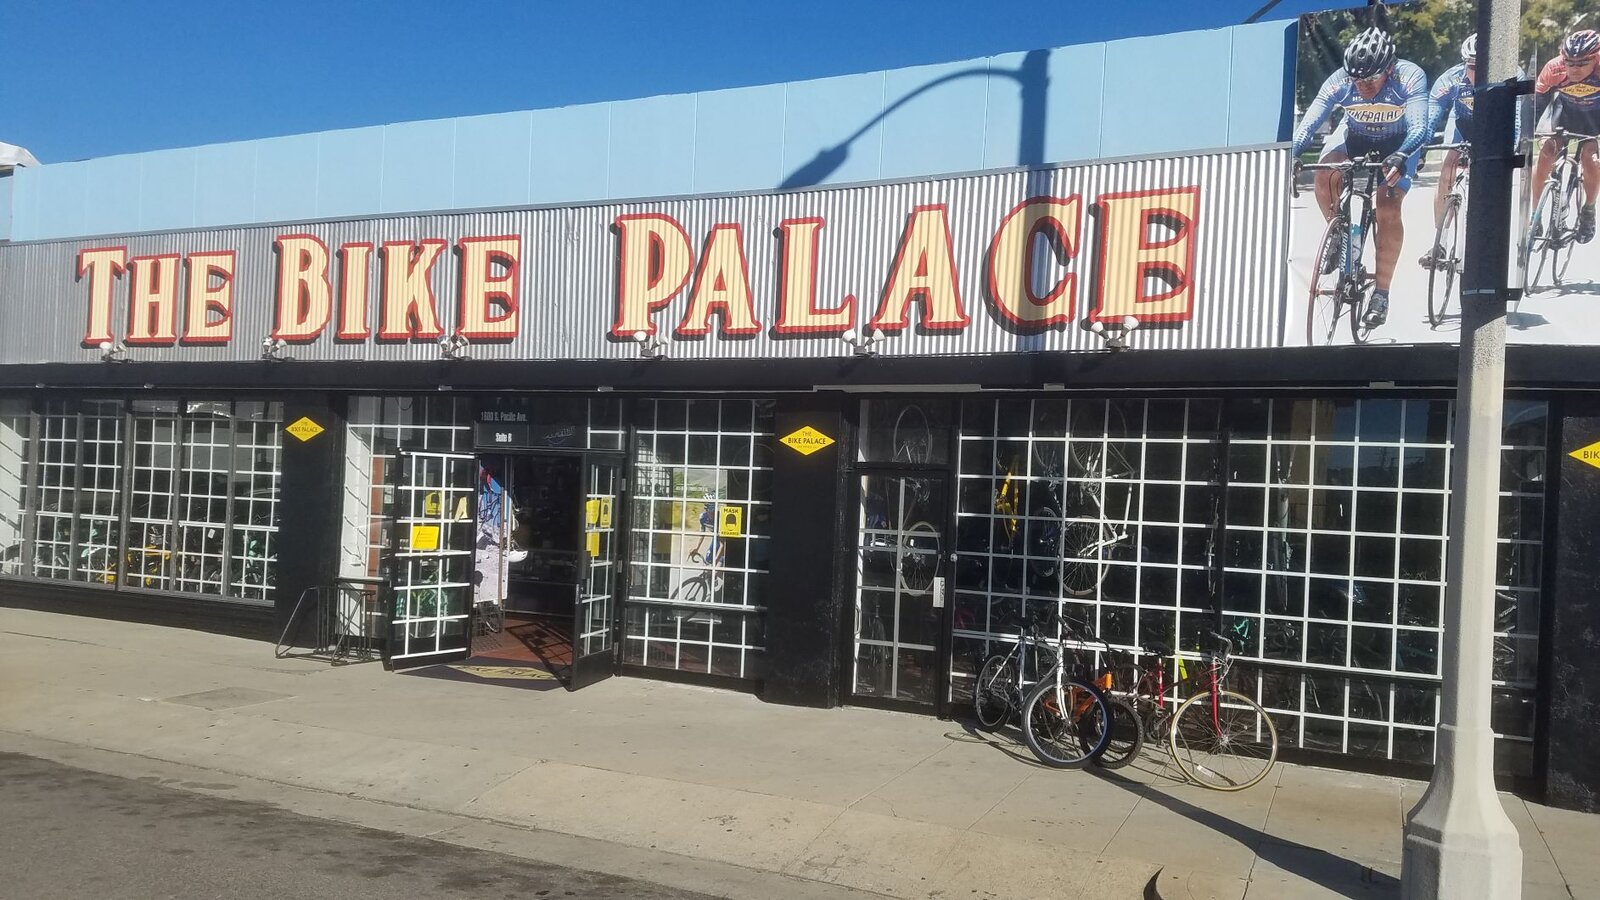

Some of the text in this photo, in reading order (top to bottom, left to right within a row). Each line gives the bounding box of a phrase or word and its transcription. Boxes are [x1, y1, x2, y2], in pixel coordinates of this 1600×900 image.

[78, 246, 236, 344] THE
[270, 234, 521, 341] BIKE
[610, 186, 1200, 335] PALACE
[802, 437, 826, 445] PALACE
